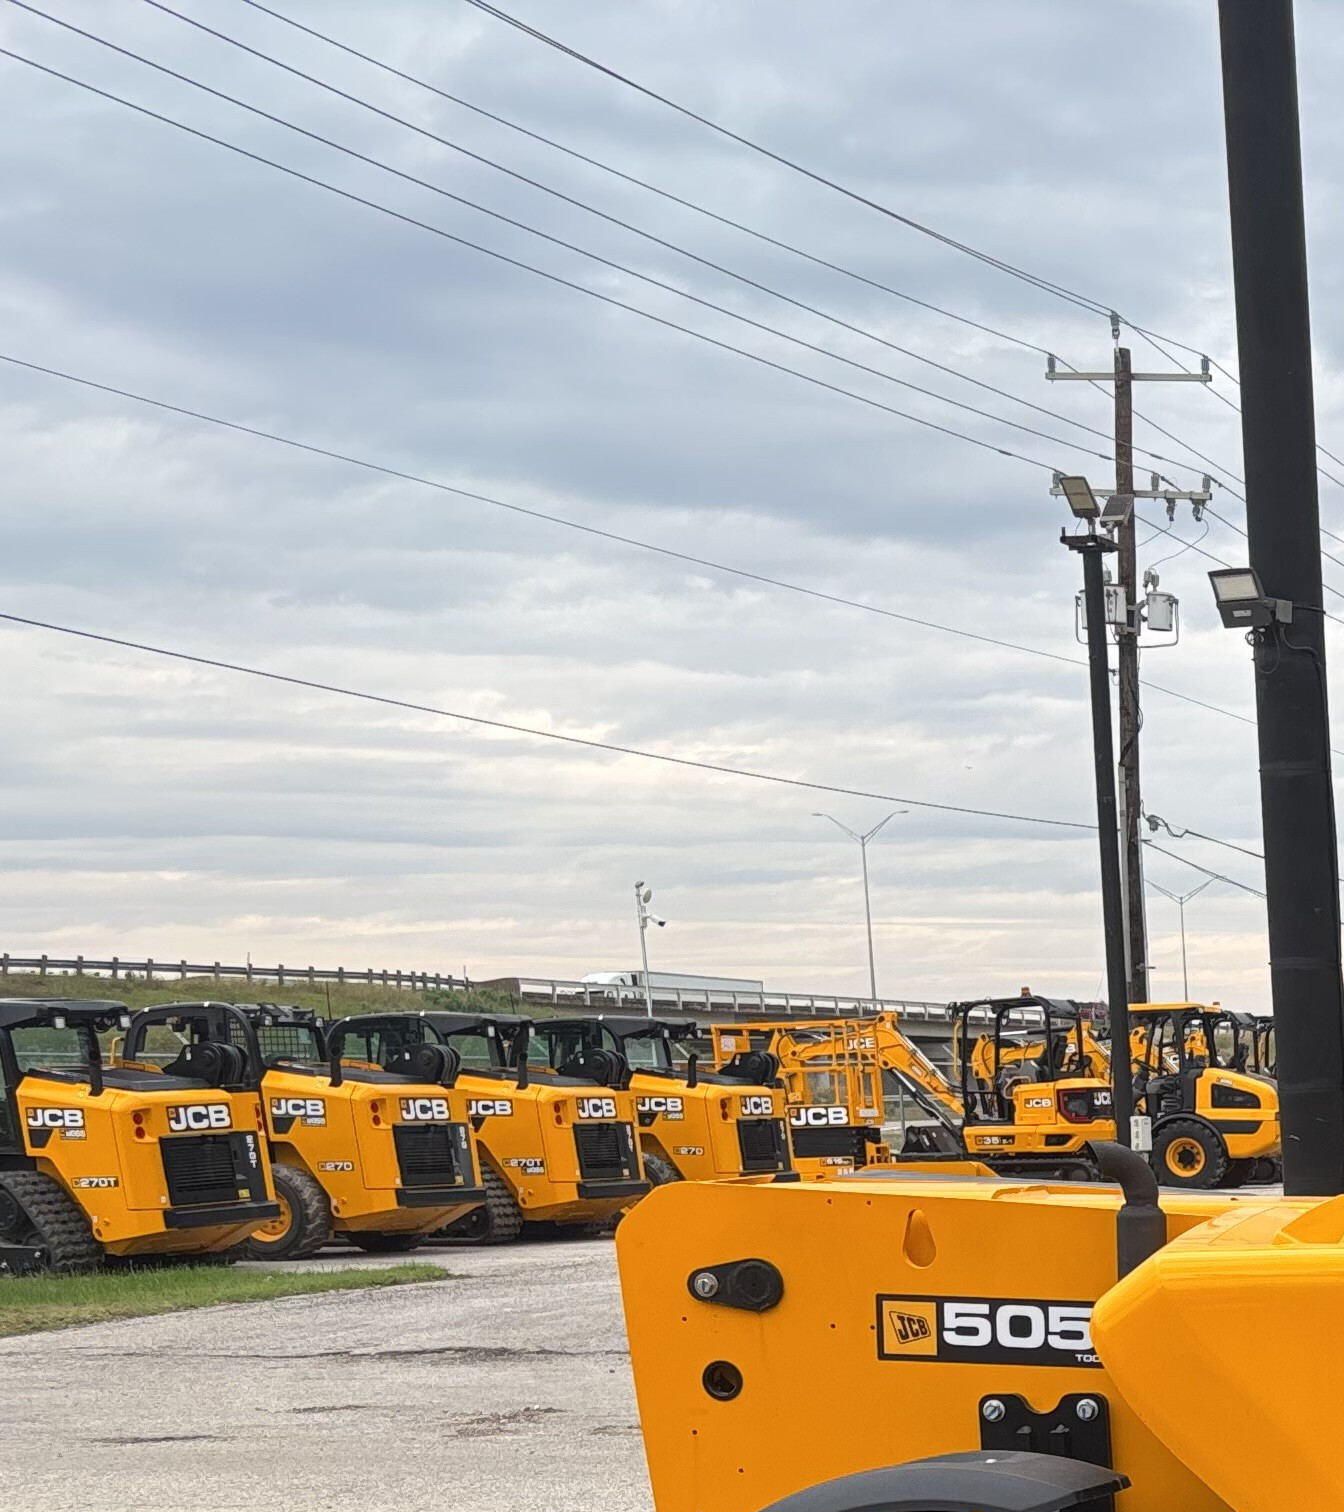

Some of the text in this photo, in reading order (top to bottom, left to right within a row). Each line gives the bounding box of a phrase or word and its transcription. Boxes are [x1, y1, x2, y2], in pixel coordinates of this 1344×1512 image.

[271, 1098, 325, 1116] JCB
[402, 1099, 450, 1120] JCB
[468, 1100, 512, 1115] JCB
[578, 1098, 616, 1118] JCB
[637, 1097, 683, 1111] JCB
[741, 1096, 773, 1115] JCB
[1025, 1099, 1052, 1107] JCB
[27, 1108, 84, 1127] JCB
[169, 1105, 231, 1131] JCB
[790, 1107, 848, 1126] JCB
[325, 1162, 353, 1171] 270
[79, 1178, 117, 1187] 270T
[896, 1315, 928, 1341] JCB
[943, 1303, 1094, 1350] 505
